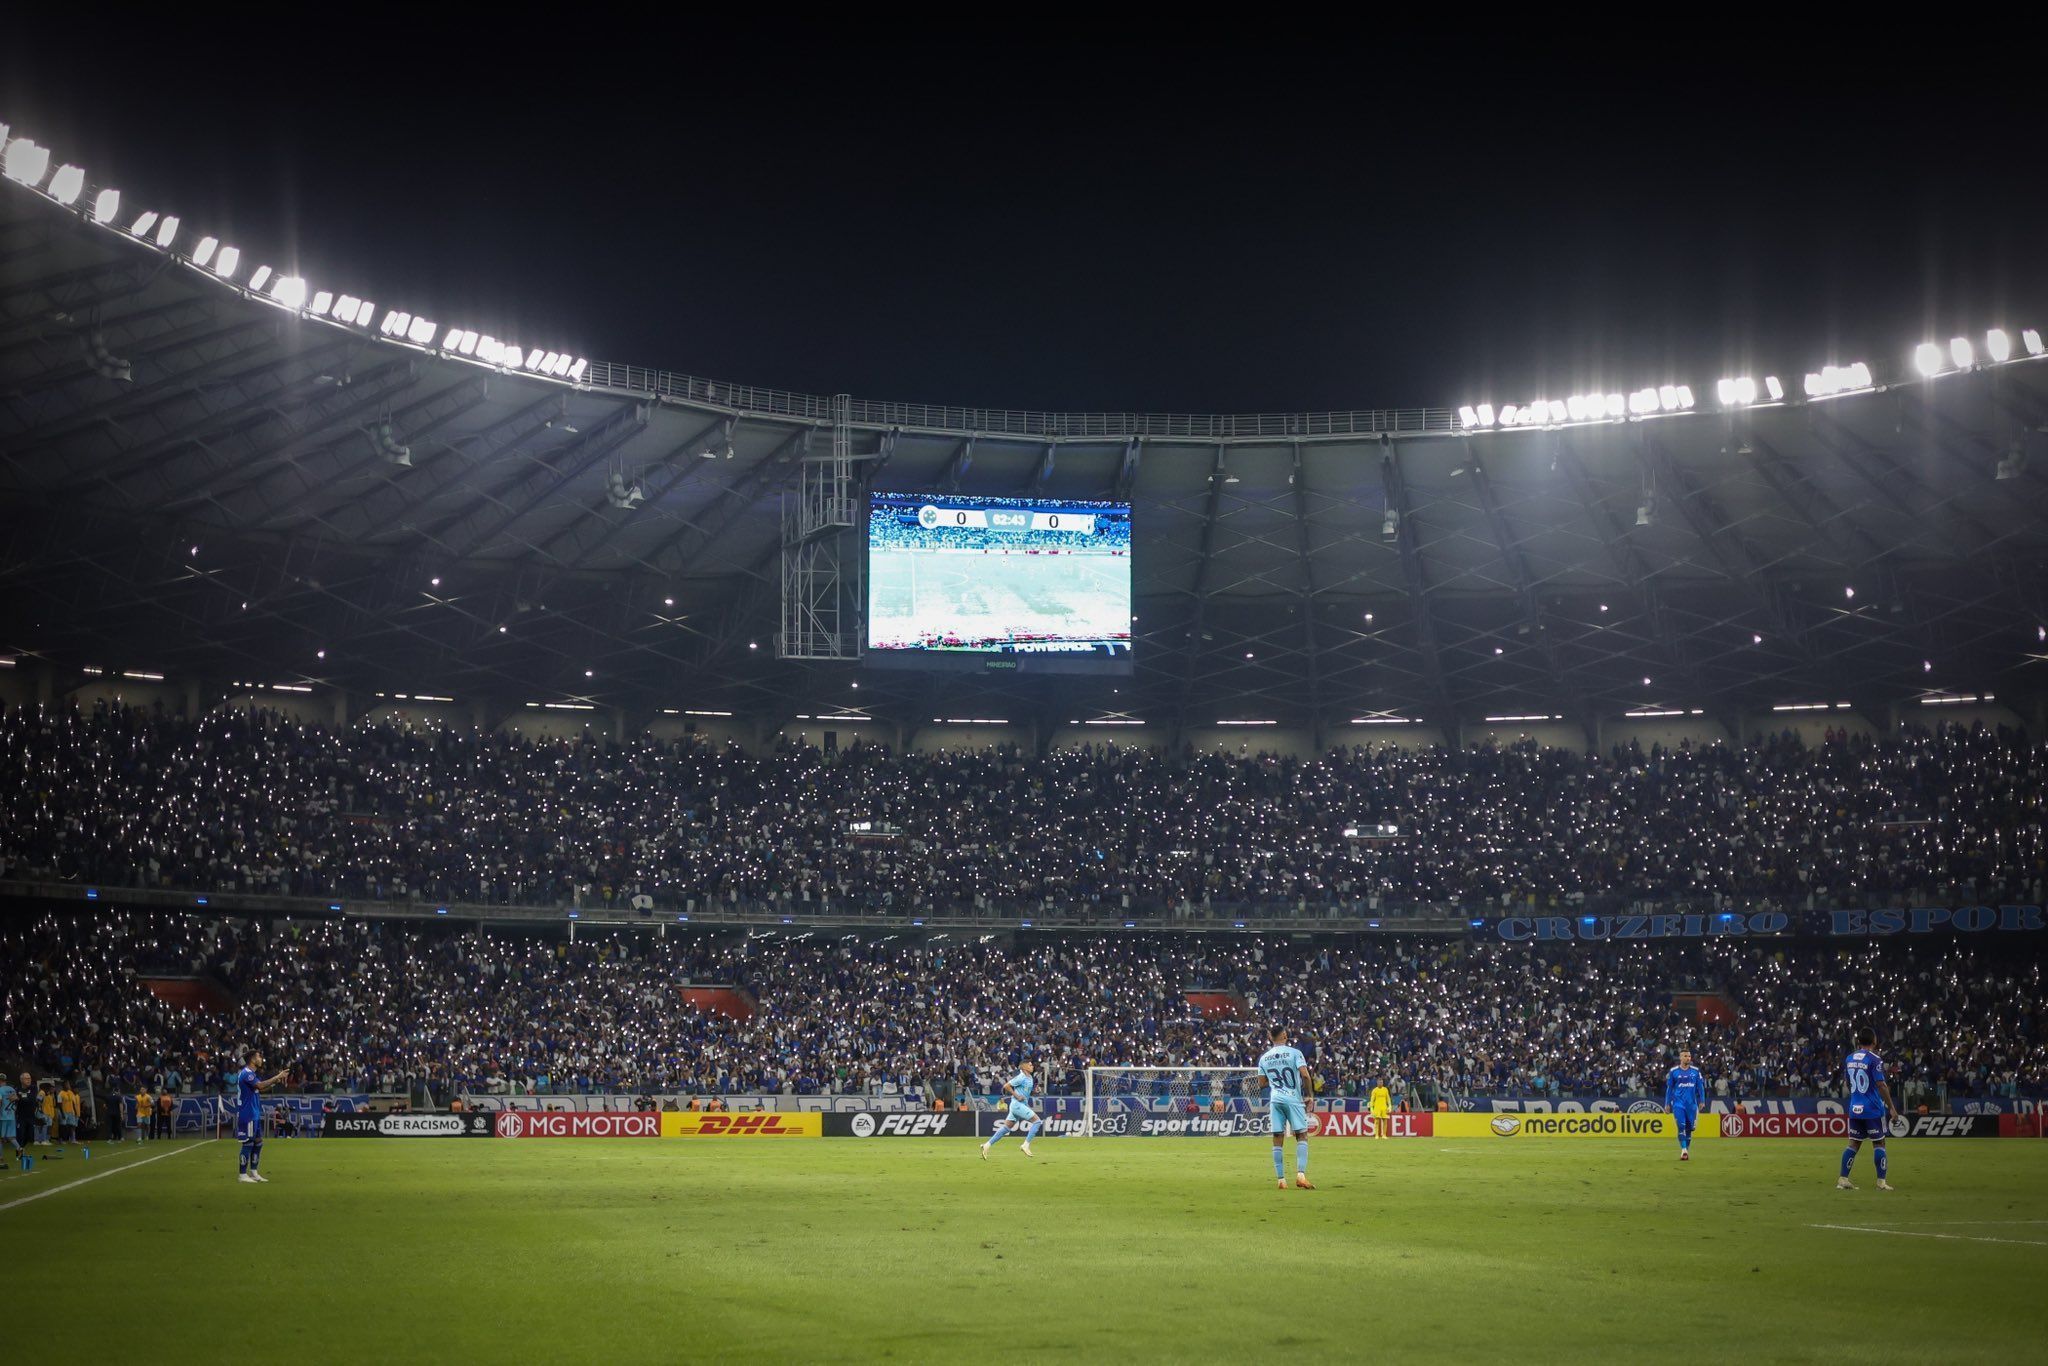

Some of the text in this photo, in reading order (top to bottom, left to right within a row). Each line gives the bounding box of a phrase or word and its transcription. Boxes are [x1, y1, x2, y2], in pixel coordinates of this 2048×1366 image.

[956, 512, 967, 525] 0
[1048, 515, 1059, 528] 0
[1498, 912, 1788, 941] CRUZEIRO
[1267, 1067, 1296, 1089] 30
[1847, 1068, 1869, 1094] 30
[335, 1119, 460, 1131] BASTA DE RACISMO
[498, 1114, 659, 1136] MG MG MOTOR
[697, 1115, 787, 1135] DHL
[855, 1118, 871, 1127] EA
[1525, 1114, 1663, 1134] mercado livre
[1750, 1117, 1780, 1134] MG
[1786, 1117, 1850, 1135] MOTO
